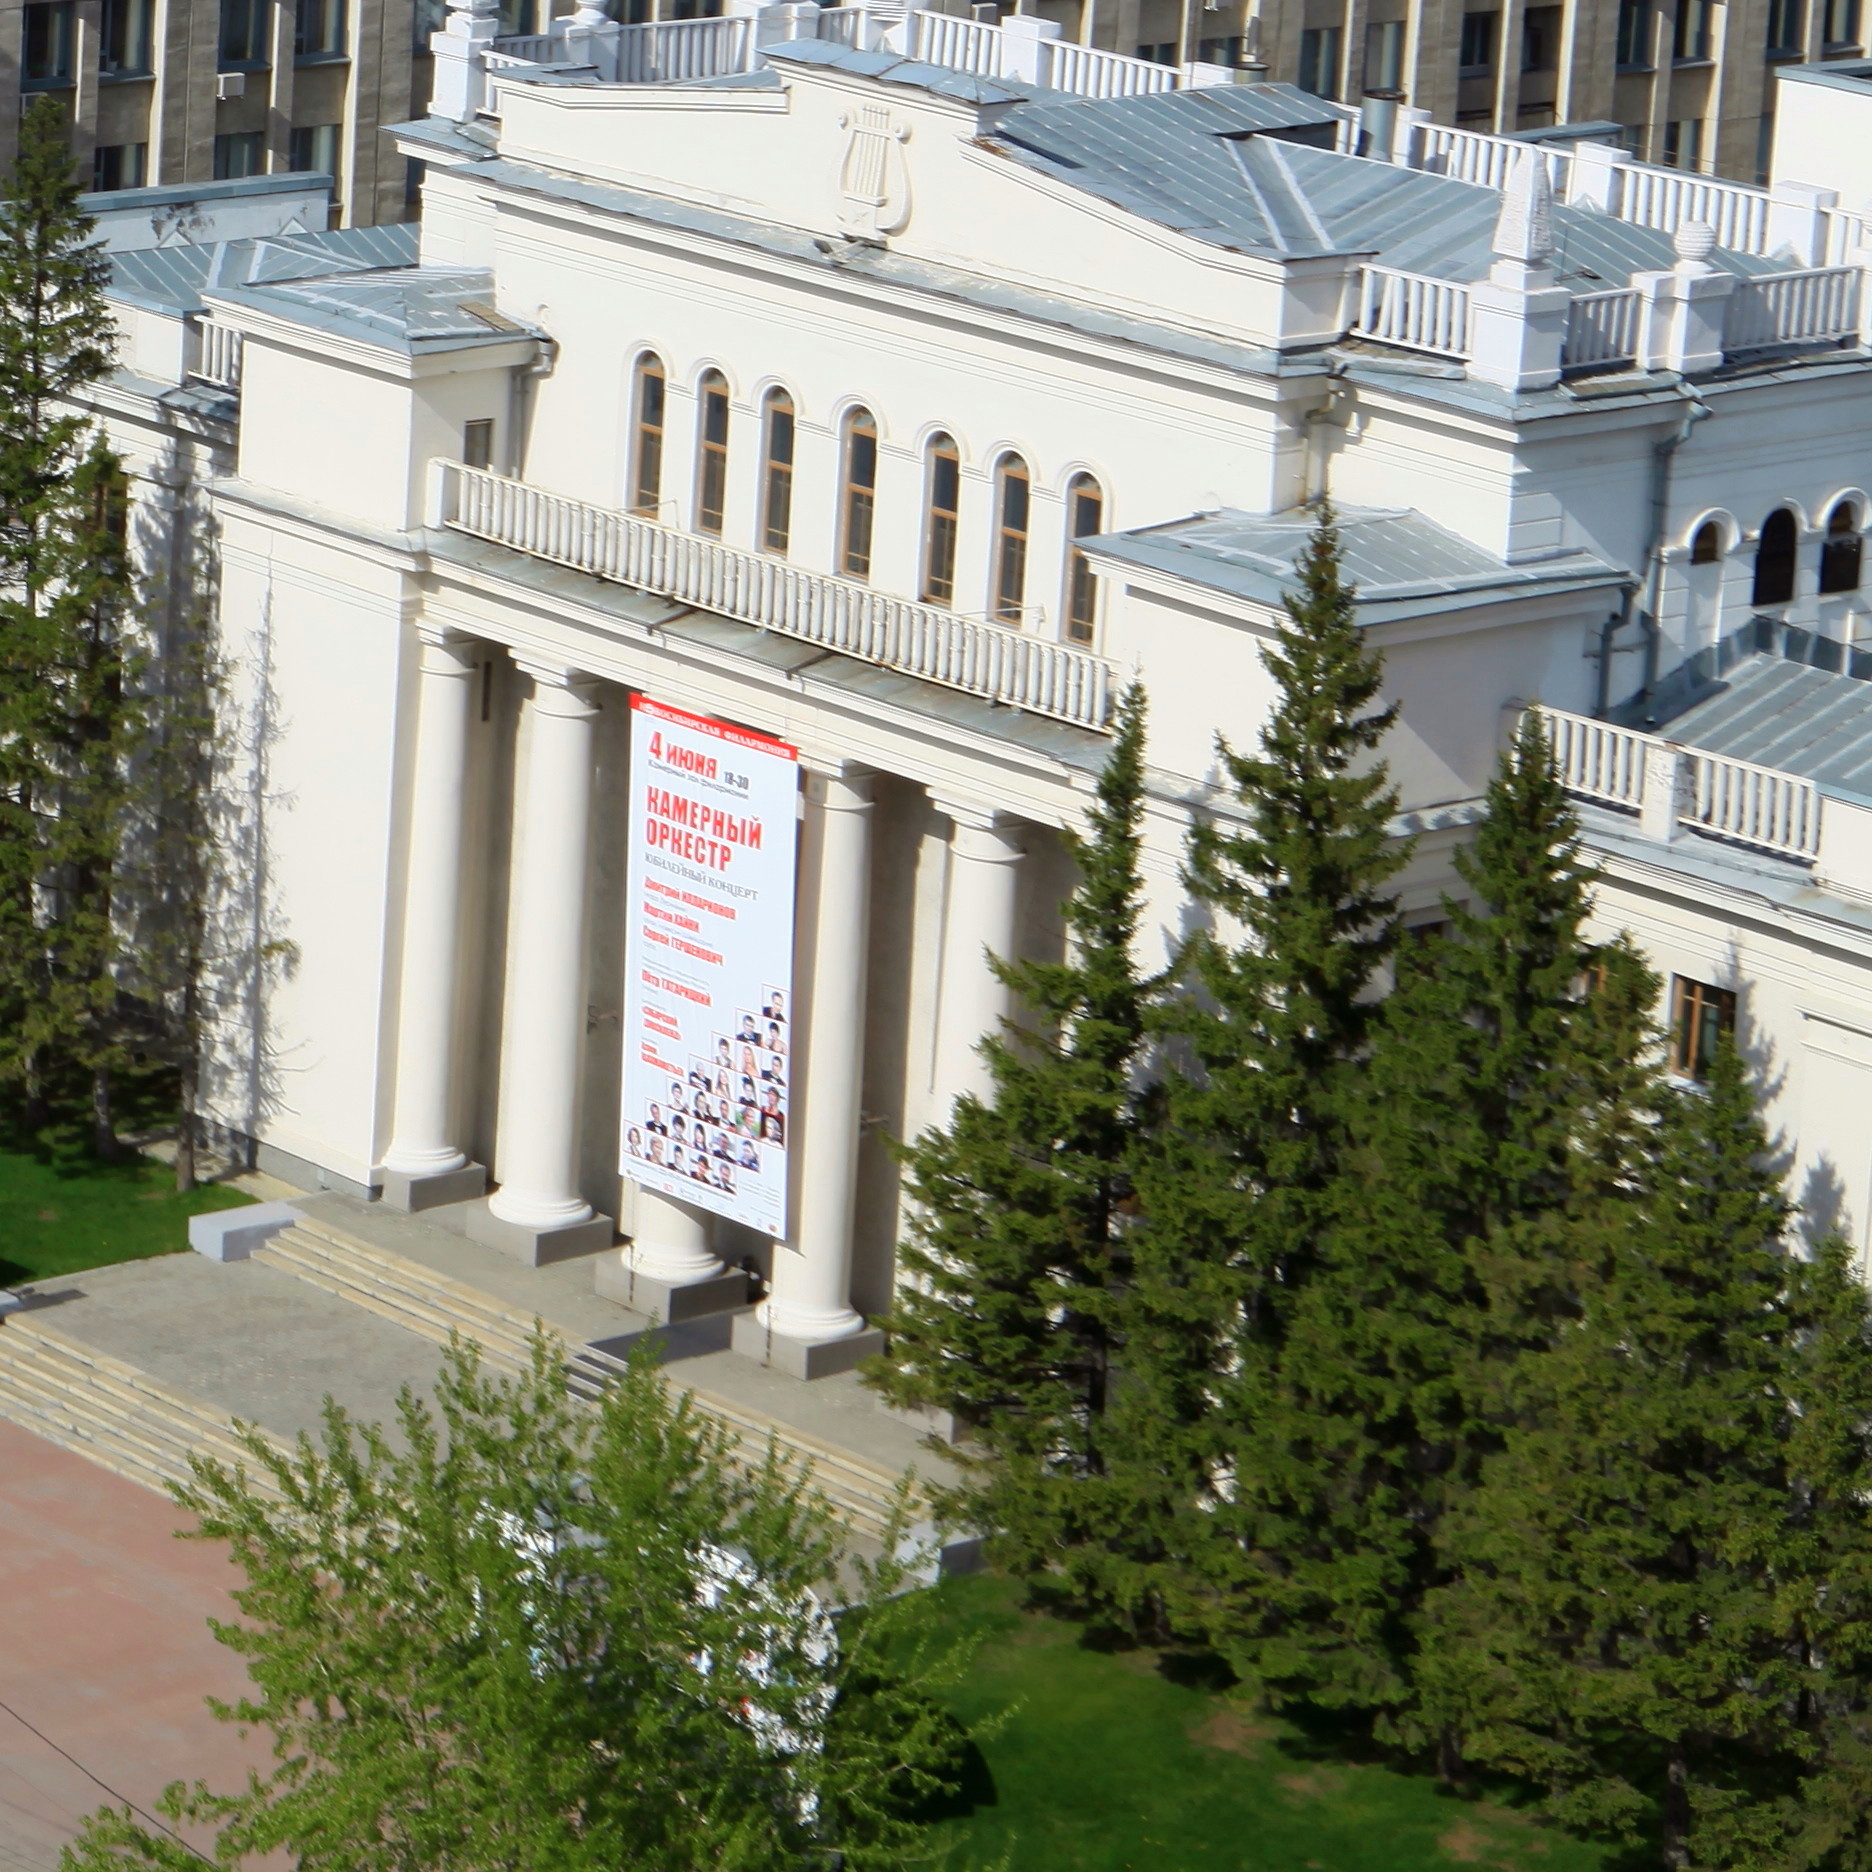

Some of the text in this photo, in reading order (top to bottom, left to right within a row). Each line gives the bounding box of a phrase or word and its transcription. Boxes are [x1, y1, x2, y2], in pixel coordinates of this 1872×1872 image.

[649, 731, 662, 760] 4
[647, 785, 763, 850] КАМЕРНЫЙ
[646, 818, 731, 871] ОРКЕСТР
[645, 852, 759, 901] ЮБИЛЕЙНЫЙ КОНЦЕРТ
